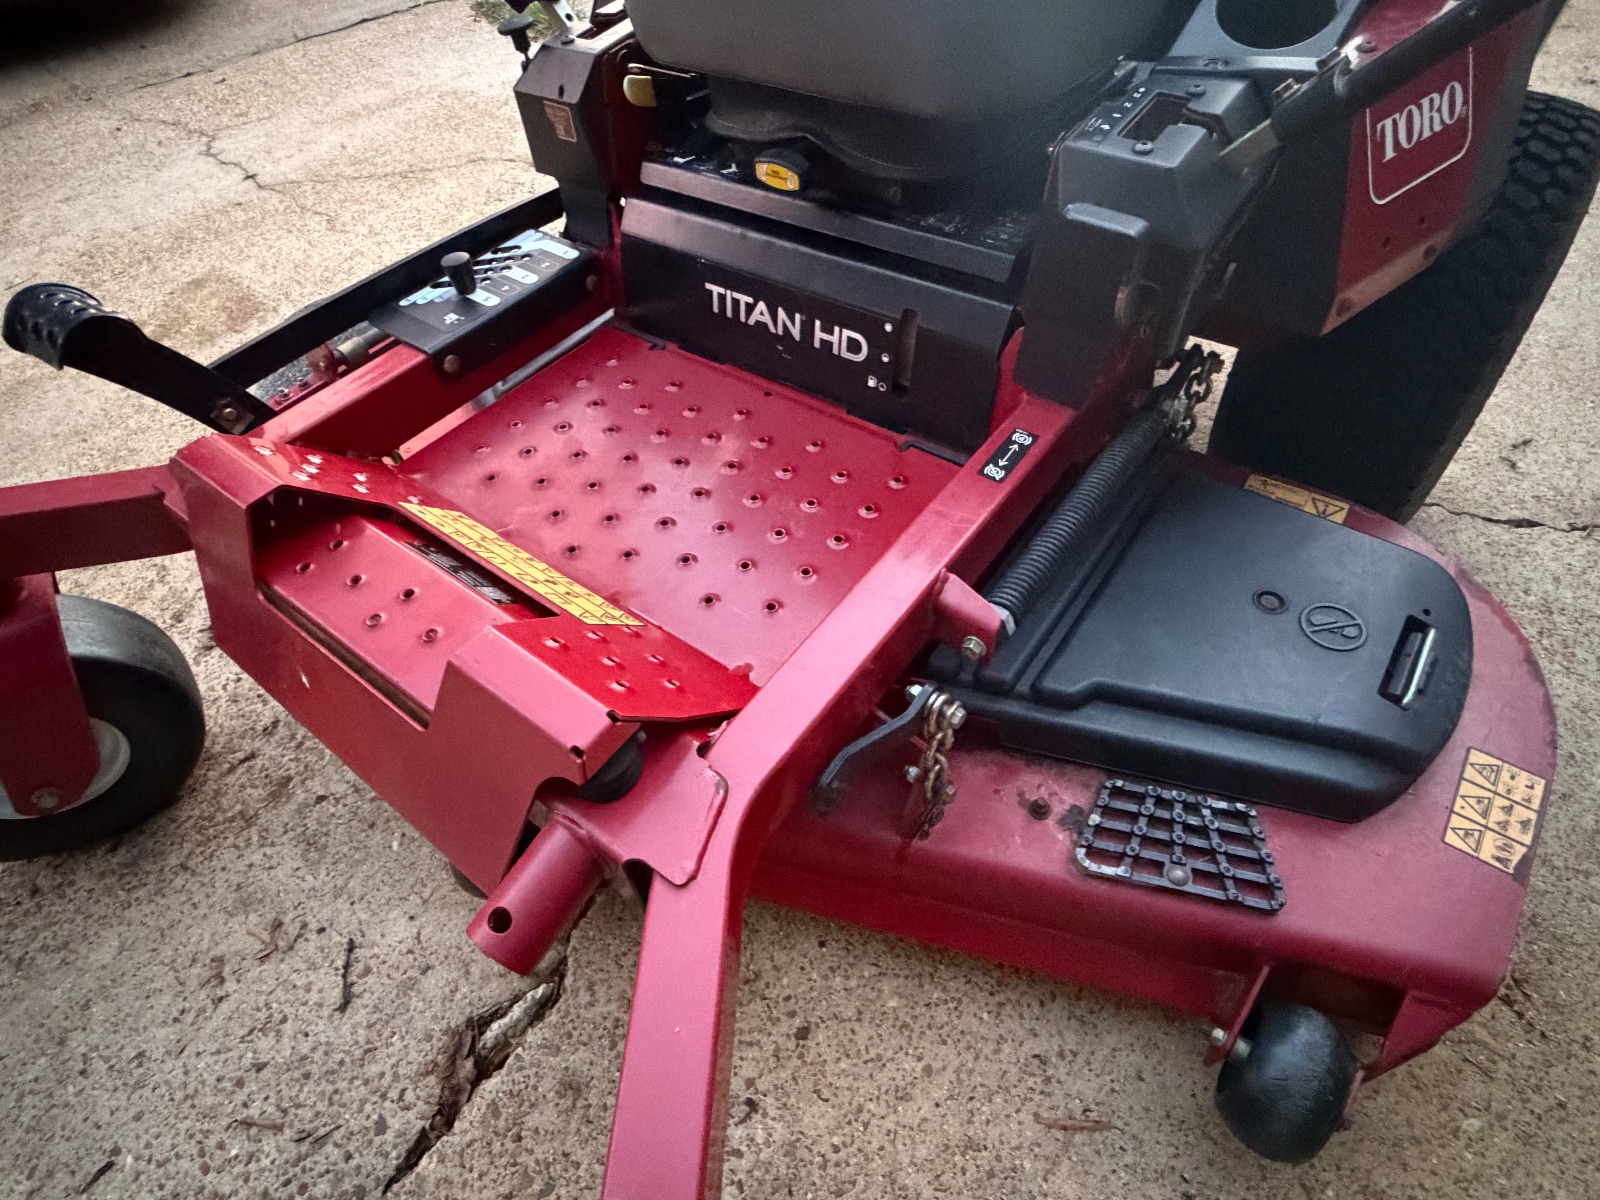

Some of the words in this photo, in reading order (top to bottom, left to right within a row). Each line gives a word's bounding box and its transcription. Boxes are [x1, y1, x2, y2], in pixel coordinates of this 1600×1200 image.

[1376, 81, 1464, 162] TORO
[704, 282, 801, 342] TITAN
[813, 318, 869, 362] HD
